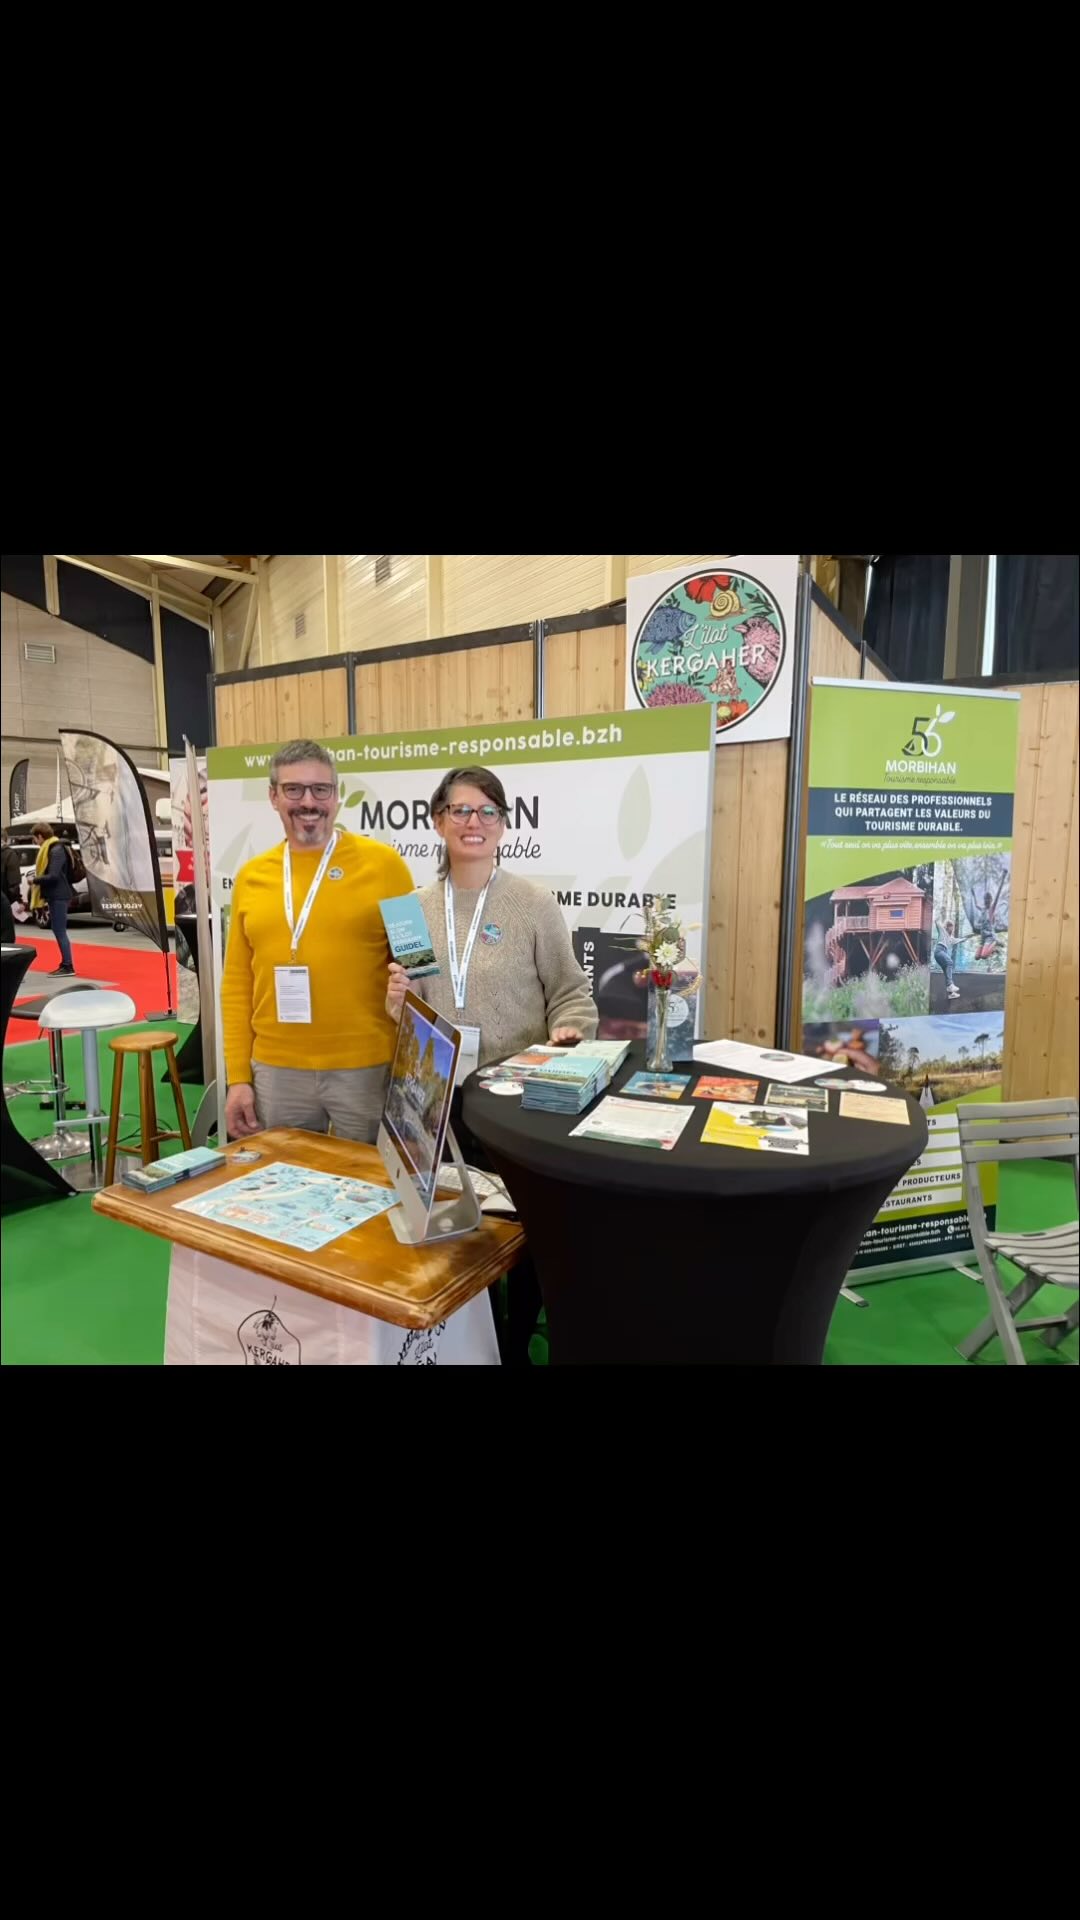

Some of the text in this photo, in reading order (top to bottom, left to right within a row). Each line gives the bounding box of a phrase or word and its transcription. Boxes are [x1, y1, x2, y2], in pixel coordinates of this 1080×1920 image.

[646, 643, 766, 676] KERGAHER
[885, 760, 957, 774] MORBIHAN
[834, 791, 992, 806] LE RÉSEAU DES PROFESSIONNELS
[835, 807, 991, 819] QUI PARTAGENT LES VALEURS DU
[865, 821, 963, 832] TOURISME DURABLE.
[588, 891, 676, 909] DURABE
[394, 941, 425, 953] GUIDEL
[902, 1172, 961, 1186] PRODUCTEURS
[881, 1194, 933, 1208] ESTAURANTS
